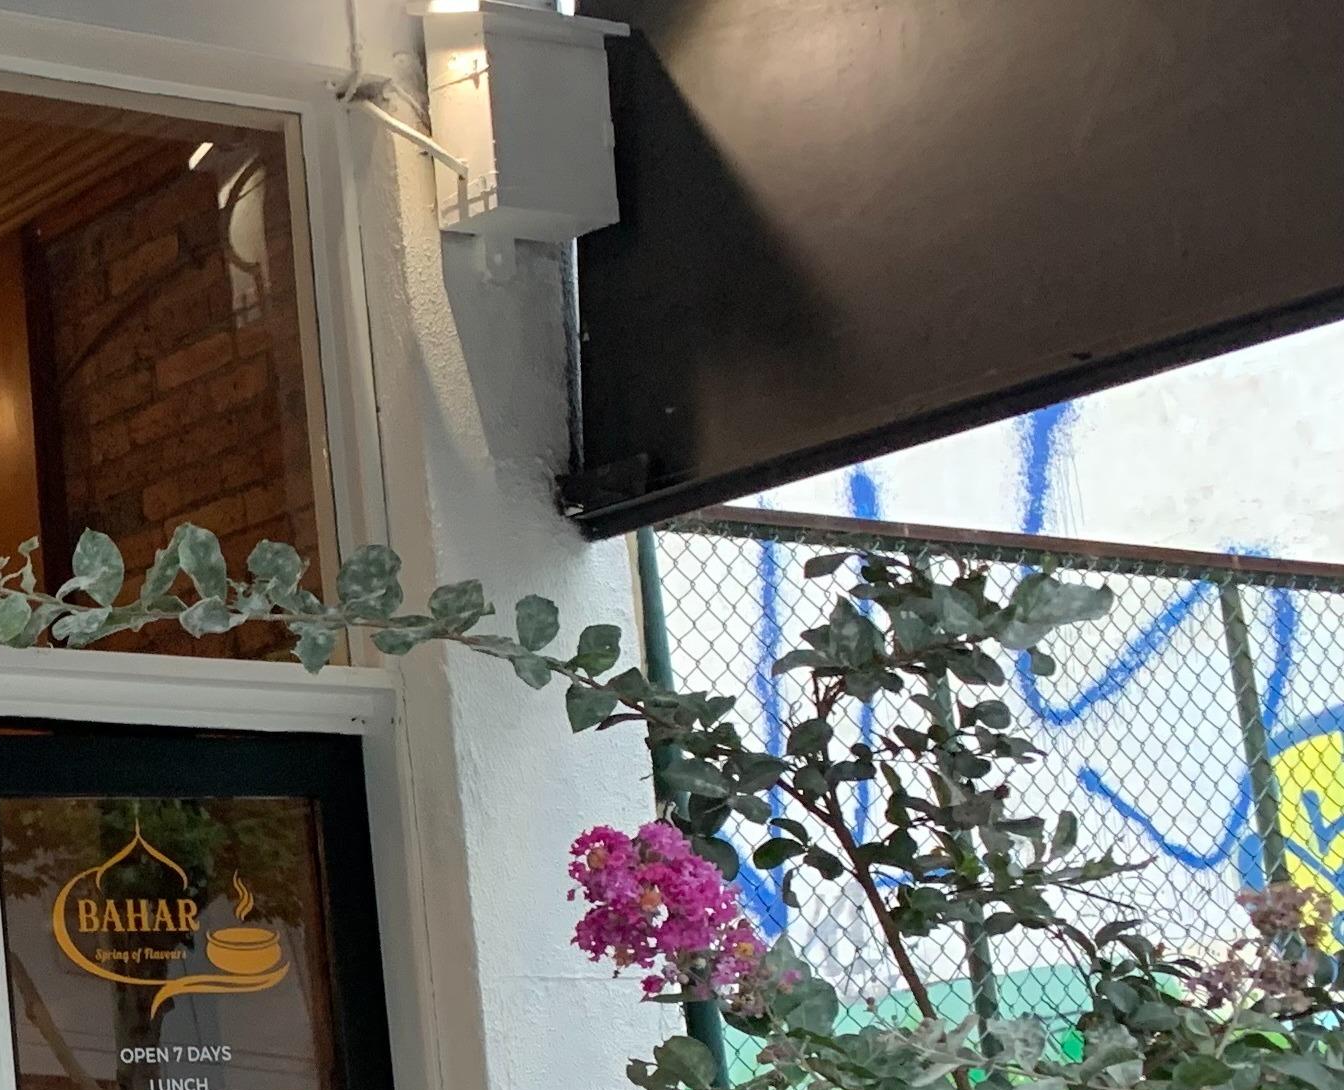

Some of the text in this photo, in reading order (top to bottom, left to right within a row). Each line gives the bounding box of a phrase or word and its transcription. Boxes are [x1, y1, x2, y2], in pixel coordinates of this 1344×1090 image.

[78, 898, 200, 932] BAHAR
[95, 948, 129, 964] Spring
[132, 947, 142, 964] of
[120, 1046, 232, 1063] OPEN 7 DAYS
